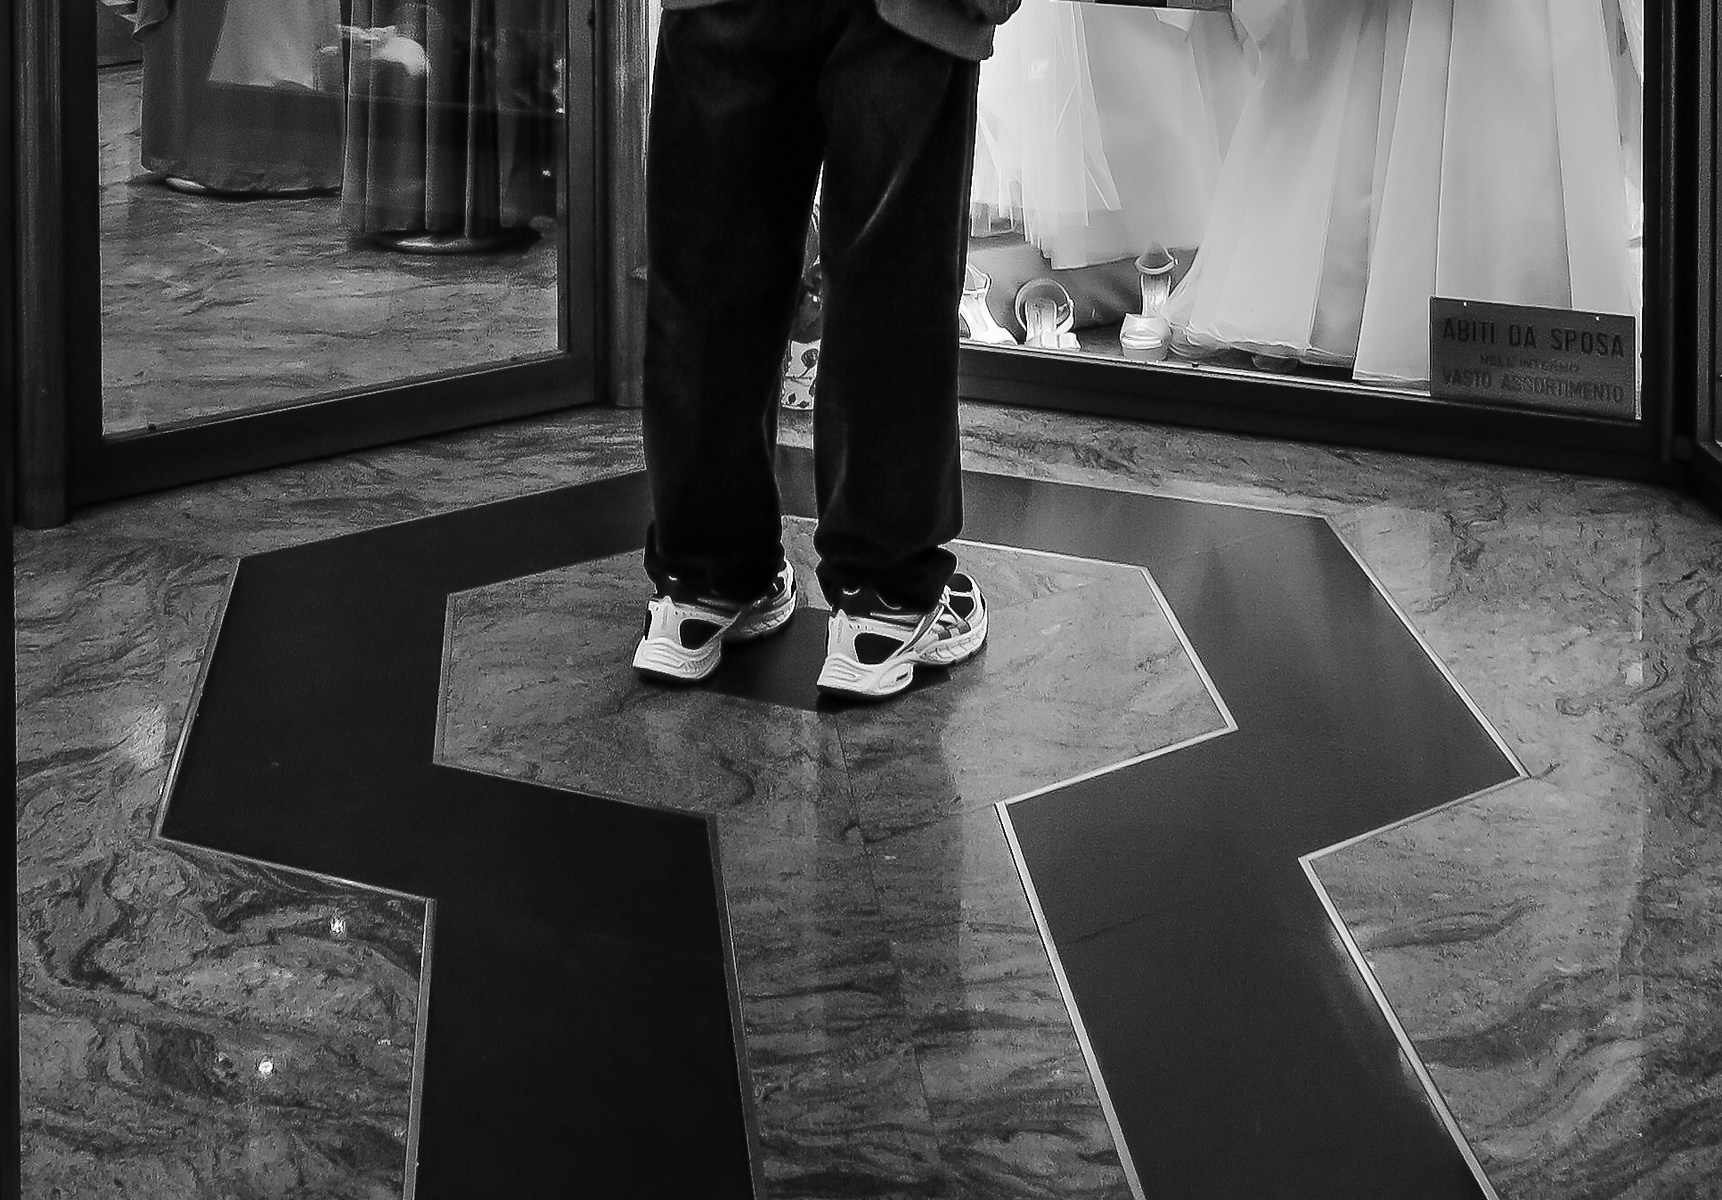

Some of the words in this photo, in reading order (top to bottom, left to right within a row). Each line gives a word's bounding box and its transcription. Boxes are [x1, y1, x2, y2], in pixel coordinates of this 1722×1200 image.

[1443, 317, 1494, 344] ABITI
[1509, 324, 1537, 349] DA
[1551, 327, 1625, 358] SPOSA
[1442, 366, 1493, 389] VASTO
[1501, 372, 1625, 404] ASSORTIMENTO
